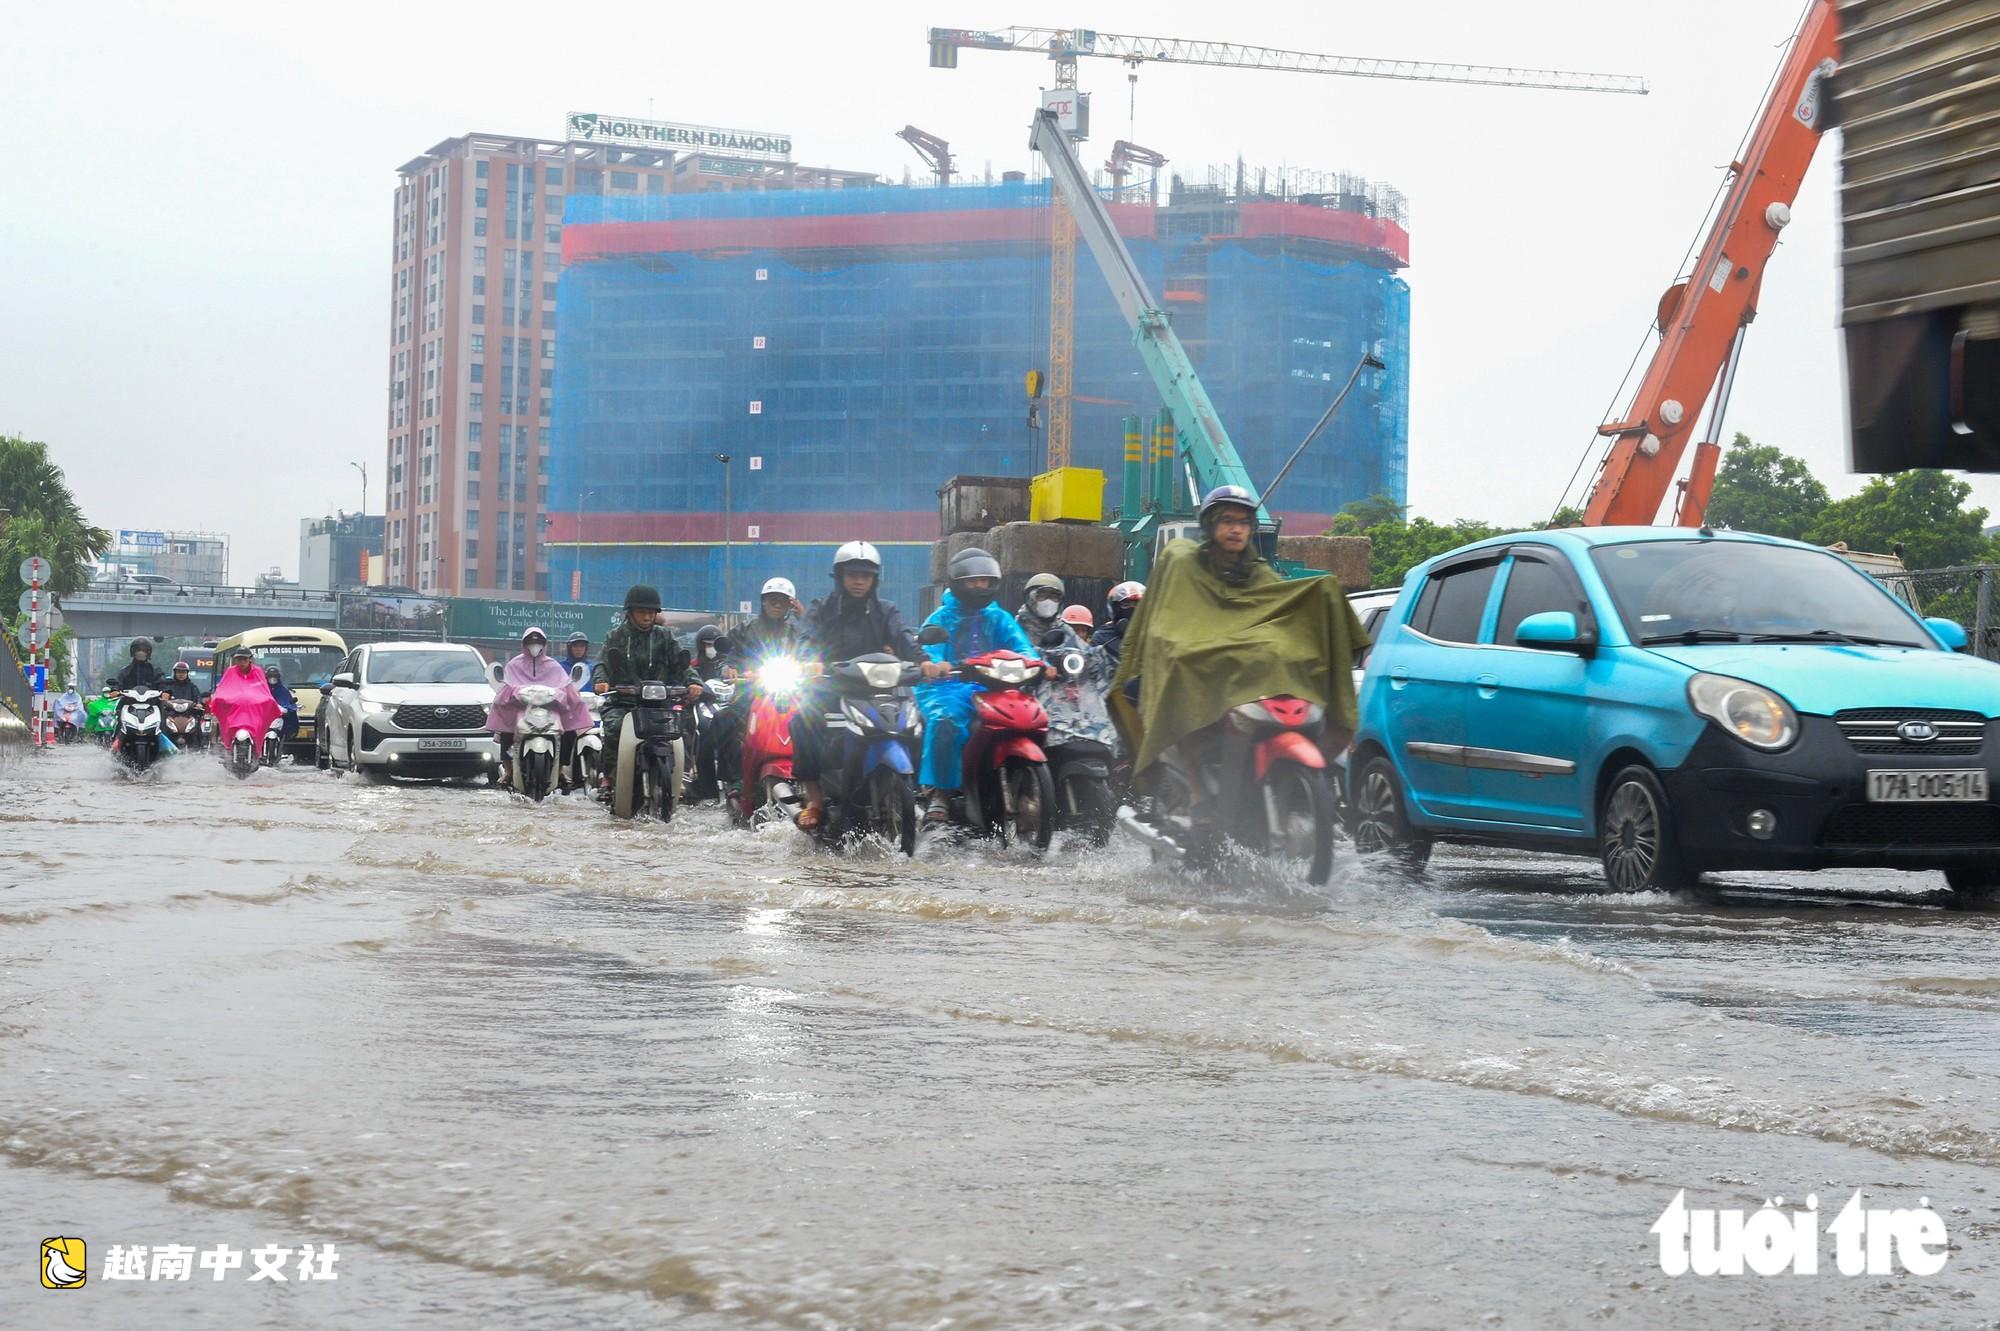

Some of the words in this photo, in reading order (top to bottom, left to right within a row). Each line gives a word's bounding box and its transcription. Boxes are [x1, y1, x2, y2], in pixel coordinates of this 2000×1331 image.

[599, 120, 705, 146] NORTHERN
[708, 132, 792, 154] DIAMOND
[755, 338, 764, 347] 12
[751, 403, 760, 411] 10
[489, 605, 508, 617] The
[510, 607, 534, 618] Lake
[535, 608, 584, 620] Colection
